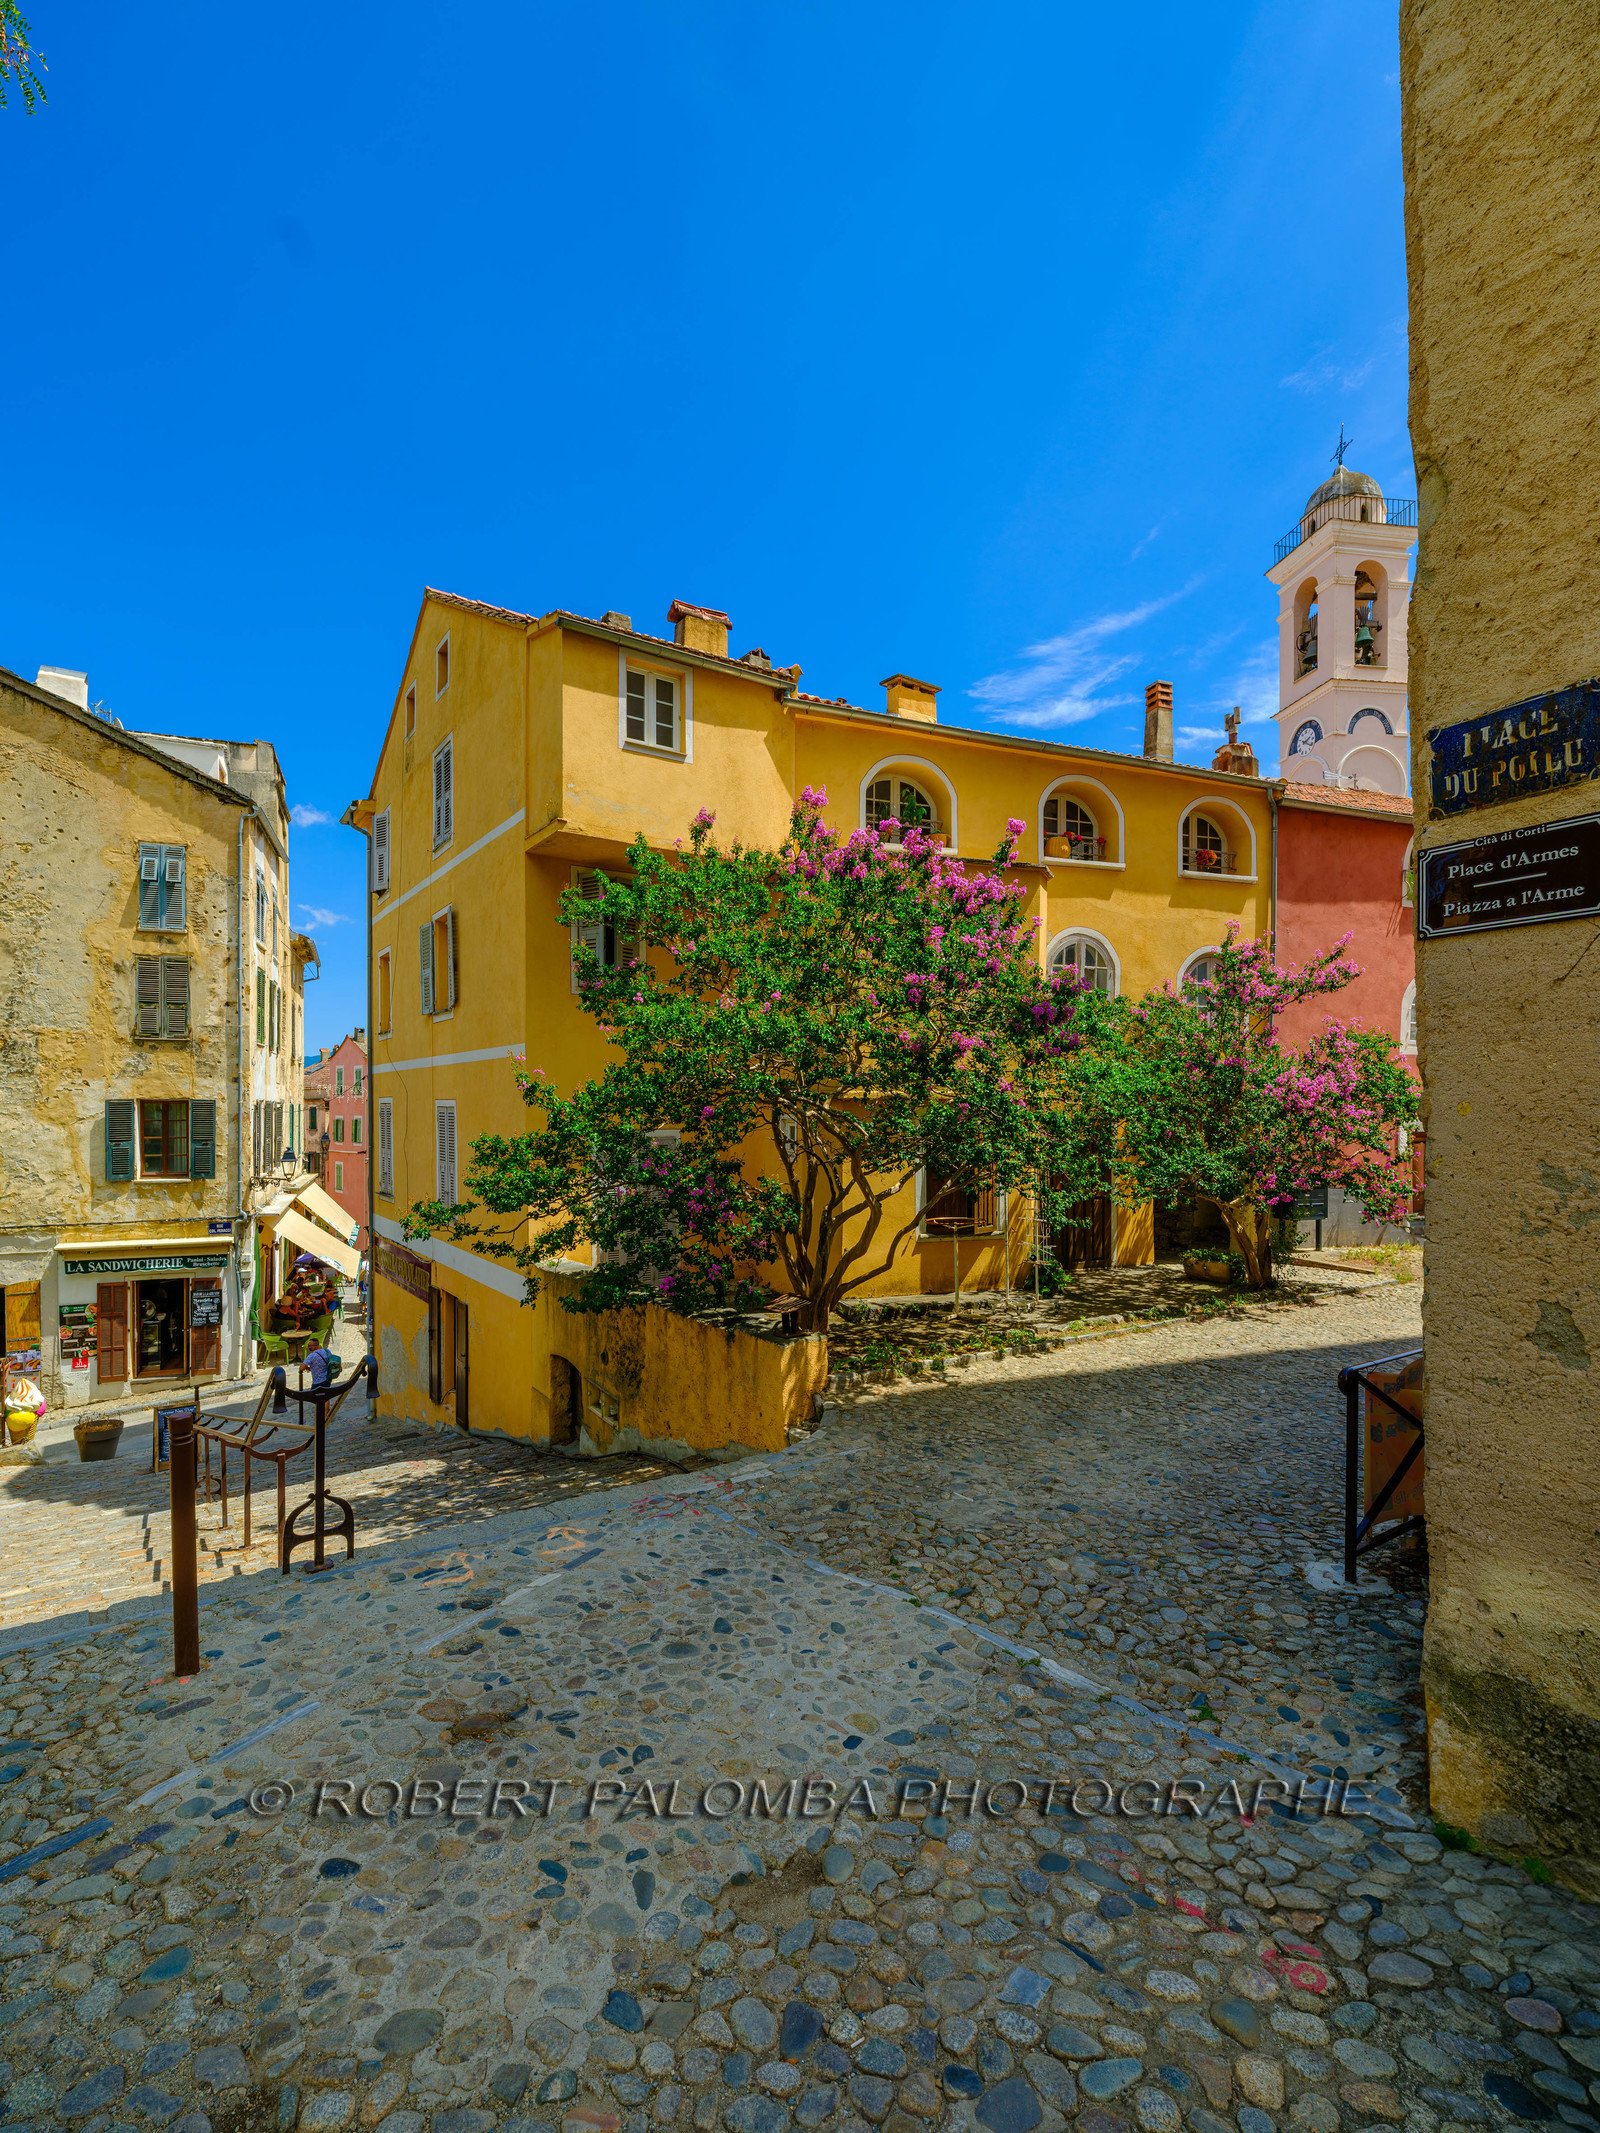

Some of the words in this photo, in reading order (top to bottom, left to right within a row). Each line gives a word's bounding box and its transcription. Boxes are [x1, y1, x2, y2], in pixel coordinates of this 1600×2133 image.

[1443, 767, 1479, 800] DU
[1491, 738, 1583, 788] POILU
[1474, 836, 1498, 847] Cità
[1500, 831, 1513, 842] di
[1515, 824, 1547, 839] Corti
[1447, 861, 1494, 880] Place
[1500, 845, 1579, 870] d'Armes
[1443, 899, 1501, 918] Piazza
[1506, 896, 1517, 908] a
[1521, 884, 1586, 905] l'Arme
[66, 1261, 85, 1273] LA
[87, 1257, 184, 1272] SANDWICHERIE
